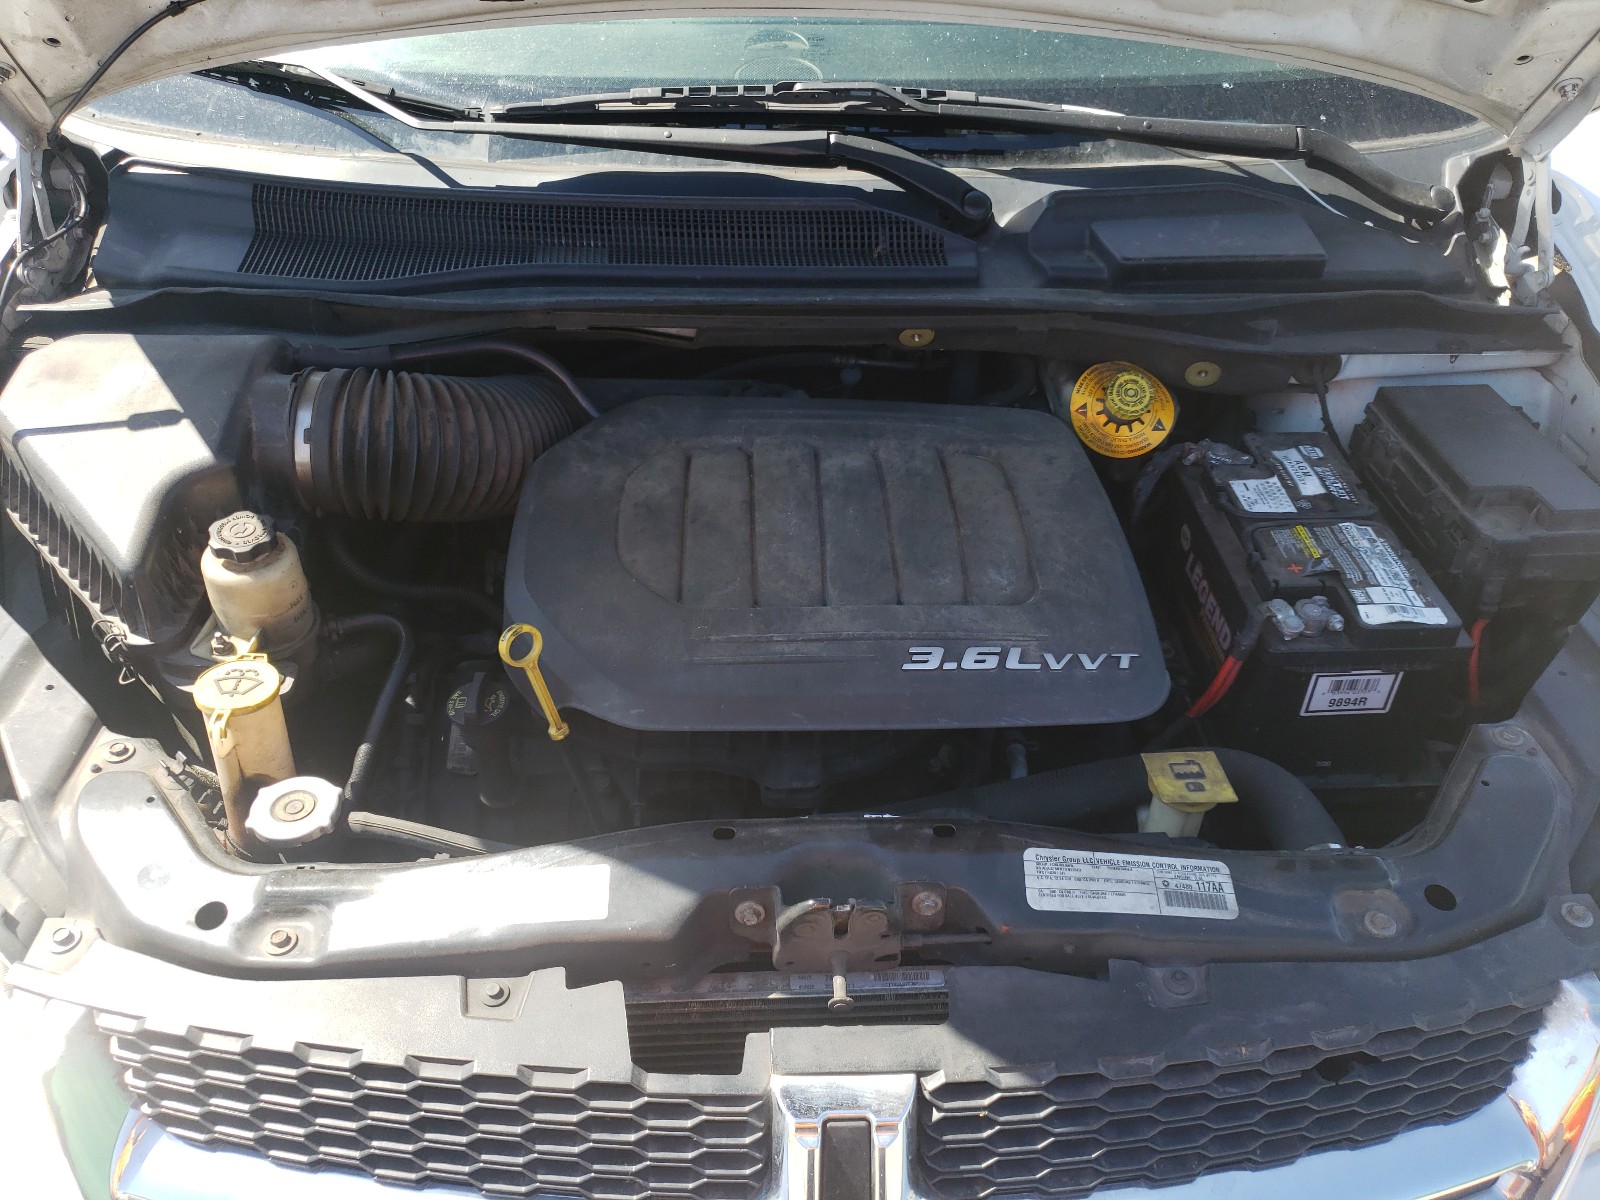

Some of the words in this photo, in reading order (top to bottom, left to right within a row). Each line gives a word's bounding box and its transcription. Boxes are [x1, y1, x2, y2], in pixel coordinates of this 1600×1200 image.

[1294, 461, 1312, 477] AGM
[1185, 551, 1231, 651] LEGEND
[901, 646, 1041, 670] 3.6L
[1042, 653, 1140, 670] VVT
[1328, 696, 1368, 708] 9894R
[1035, 853, 1060, 863] Chrysler
[1062, 856, 1080, 864] Group
[1122, 860, 1151, 868] EMISSION
[1152, 862, 1178, 870] CONTROL
[1180, 864, 1220, 874] INFORMATION
[1196, 882, 1224, 893] 117AA
